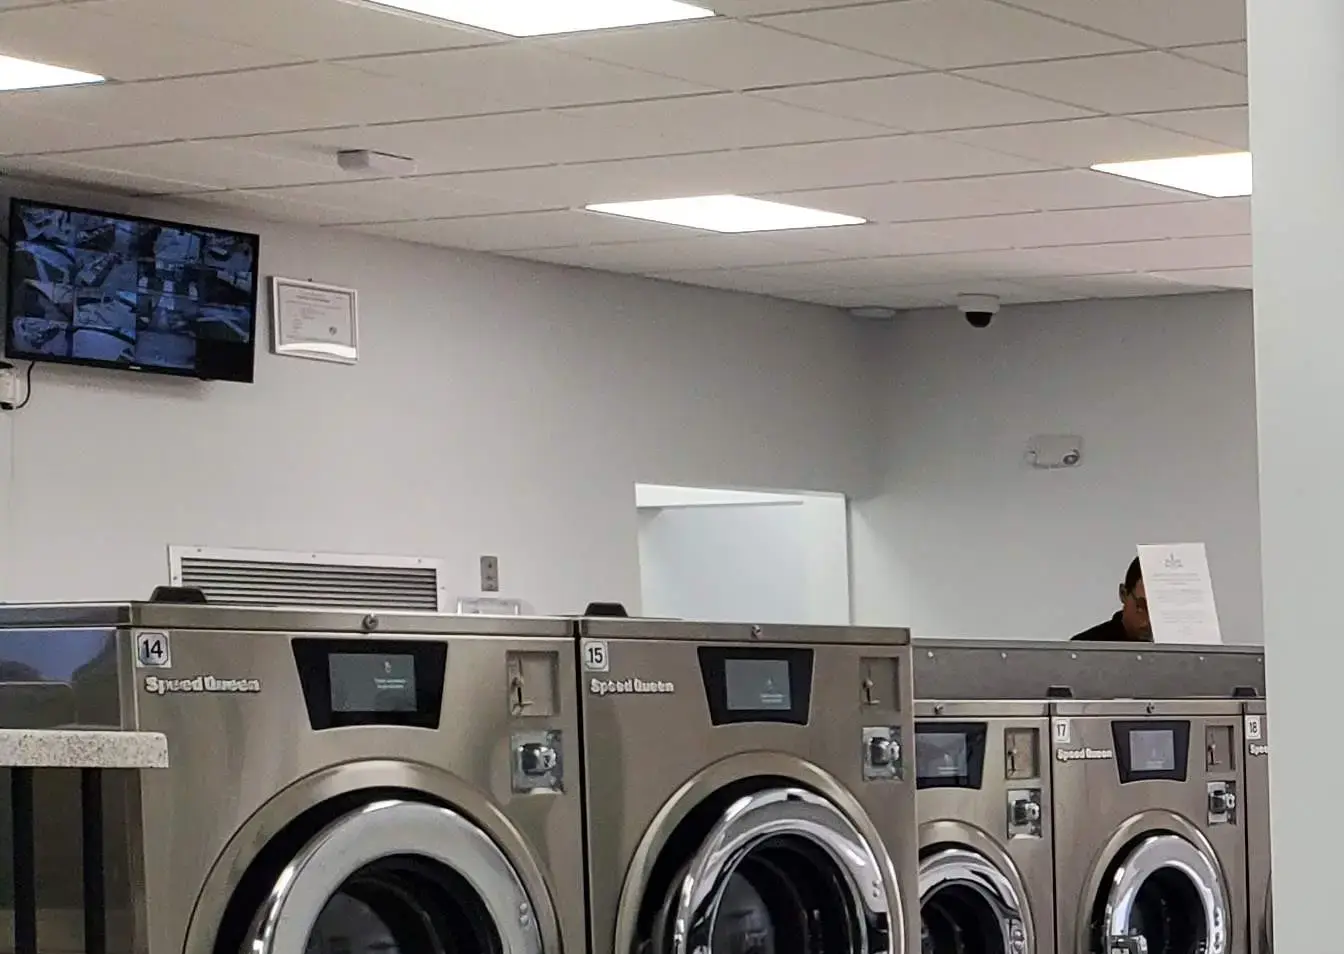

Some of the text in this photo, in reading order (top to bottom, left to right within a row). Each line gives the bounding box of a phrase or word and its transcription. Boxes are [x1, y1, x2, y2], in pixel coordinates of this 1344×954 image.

[143, 639, 164, 659] 14
[588, 647, 603, 664] 15
[146, 675, 261, 694] Speed Queen
[590, 678, 675, 695] Speed Queen
[1056, 725, 1066, 738] 17
[1249, 722, 1257, 735] 18
